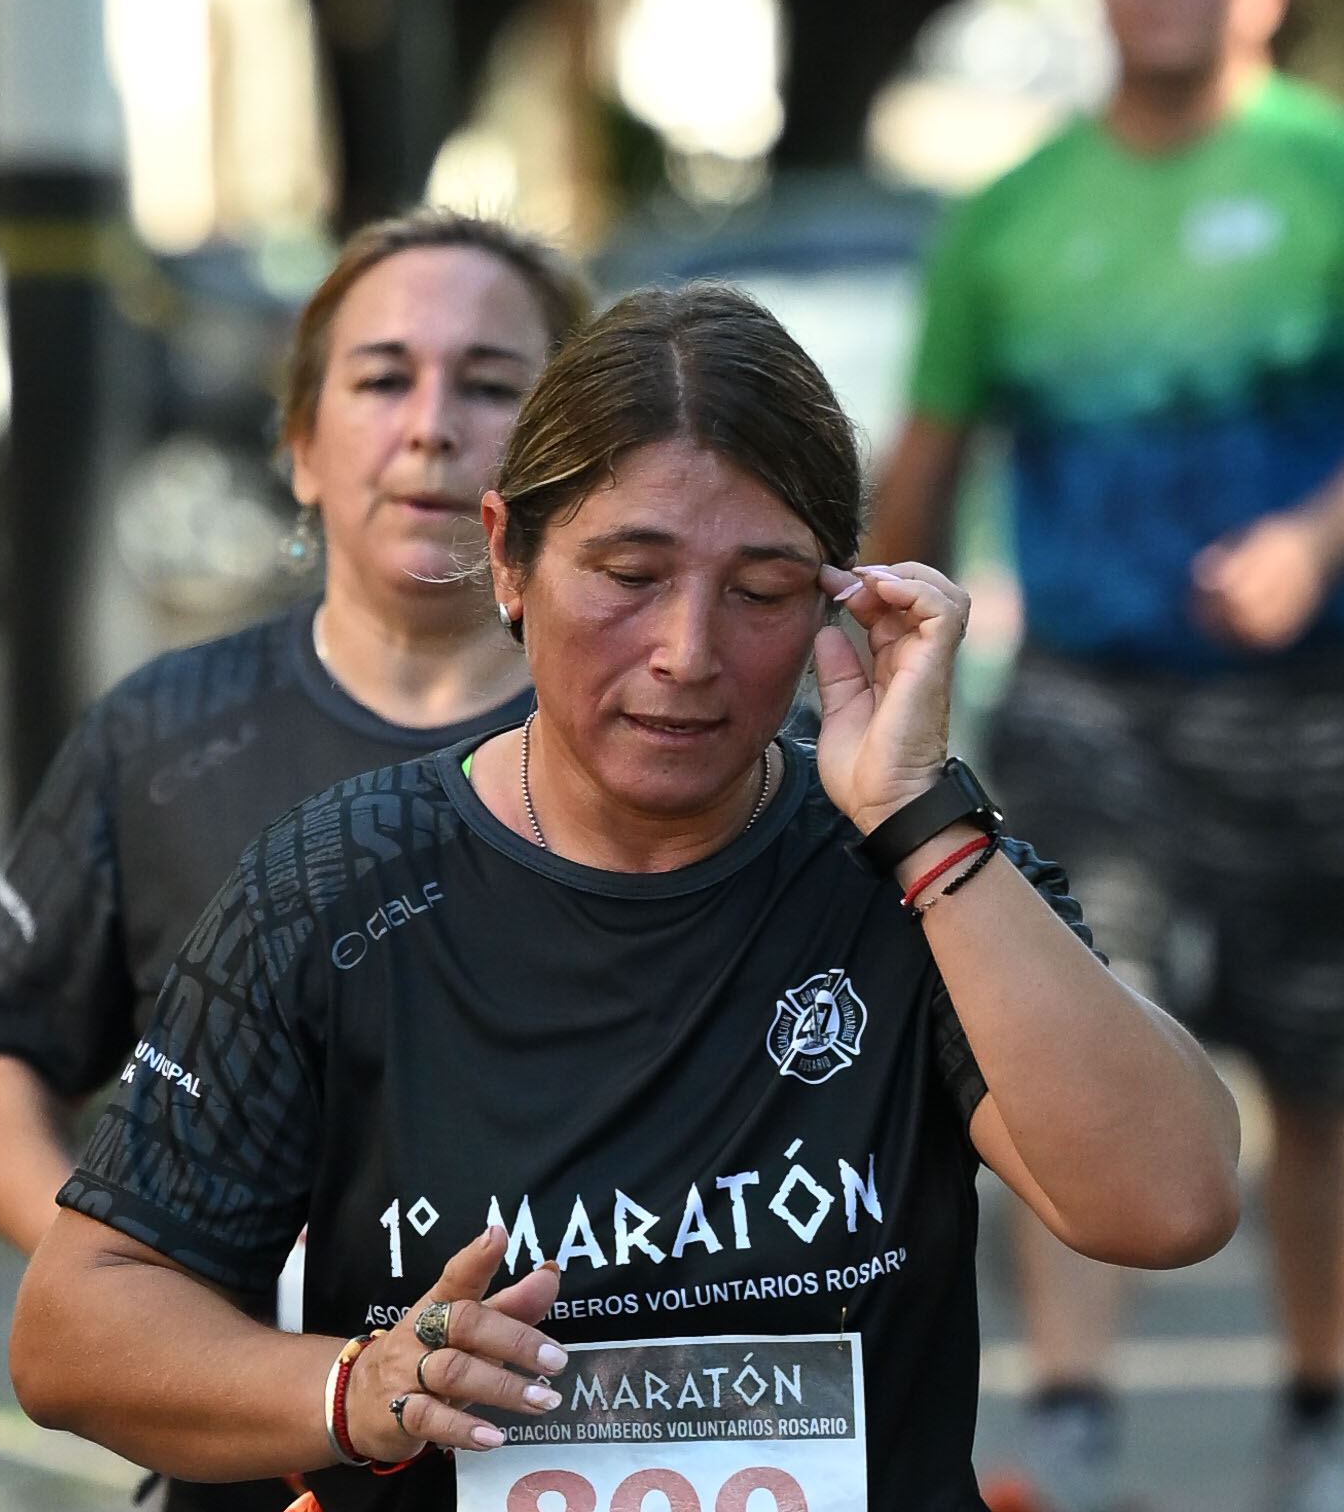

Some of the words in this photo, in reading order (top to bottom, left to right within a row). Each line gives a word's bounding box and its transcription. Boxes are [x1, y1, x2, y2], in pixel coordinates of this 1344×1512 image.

[488, 1138, 883, 1276] MARATÓN
[645, 1272, 819, 1312] VOLUNTARIOS
[570, 1352, 803, 1412] MARATÓN
[499, 1419, 572, 1442] OCIACIÓN
[576, 1420, 662, 1440] BOMBEROS
[667, 1418, 774, 1438] VOLUNTARIOS
[778, 1416, 848, 1437] ROSARIO
